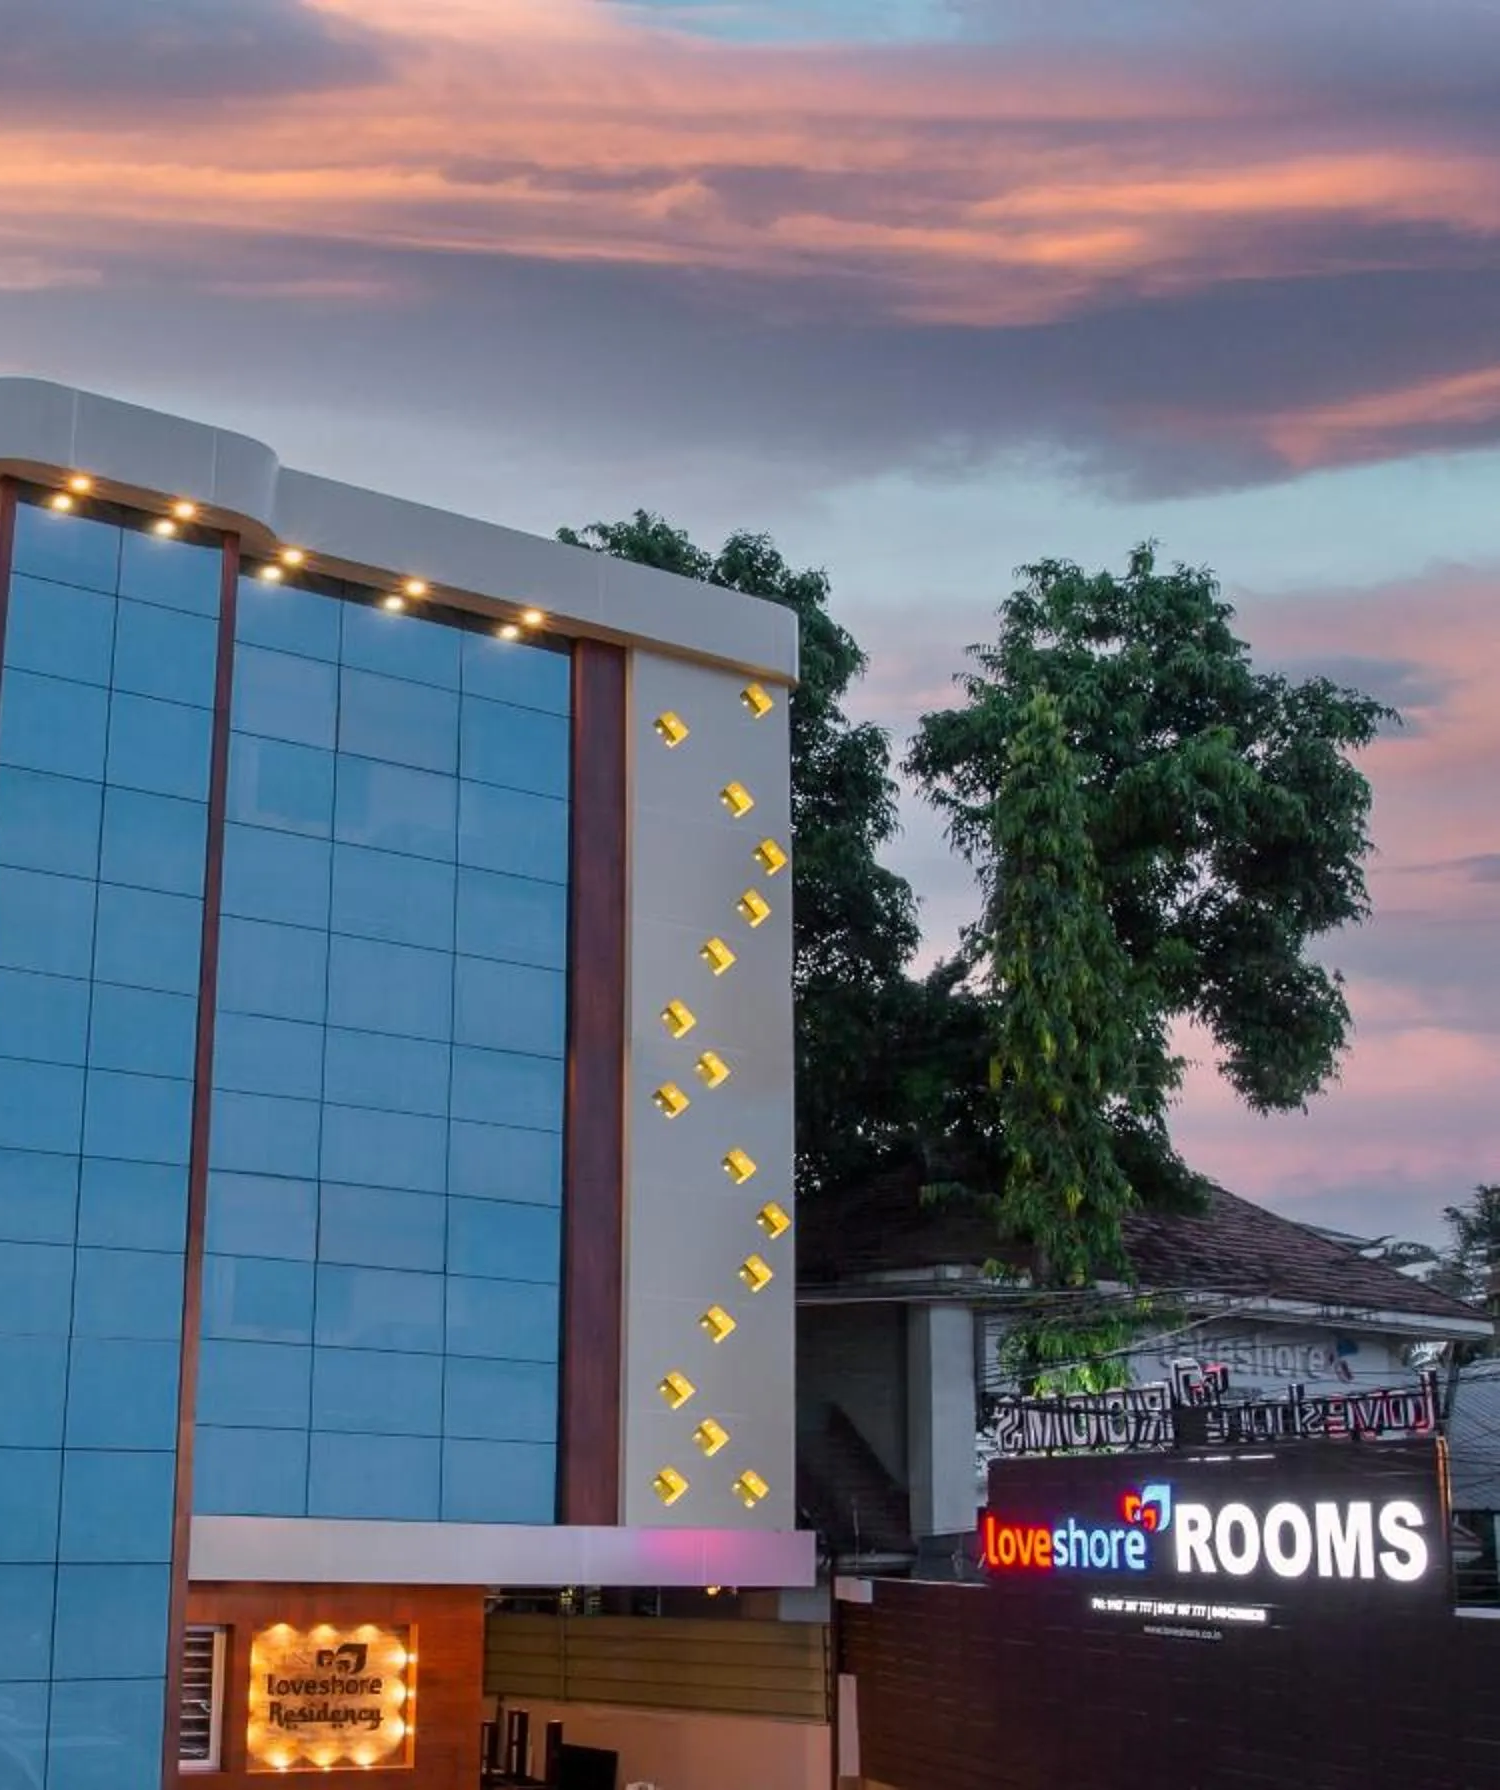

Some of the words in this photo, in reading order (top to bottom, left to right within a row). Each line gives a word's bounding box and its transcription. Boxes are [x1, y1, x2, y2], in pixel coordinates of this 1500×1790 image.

[986, 1516, 1146, 1570] loveshore
[1175, 1501, 1429, 1583] ROOMS
[268, 1701, 384, 1731] Residency
